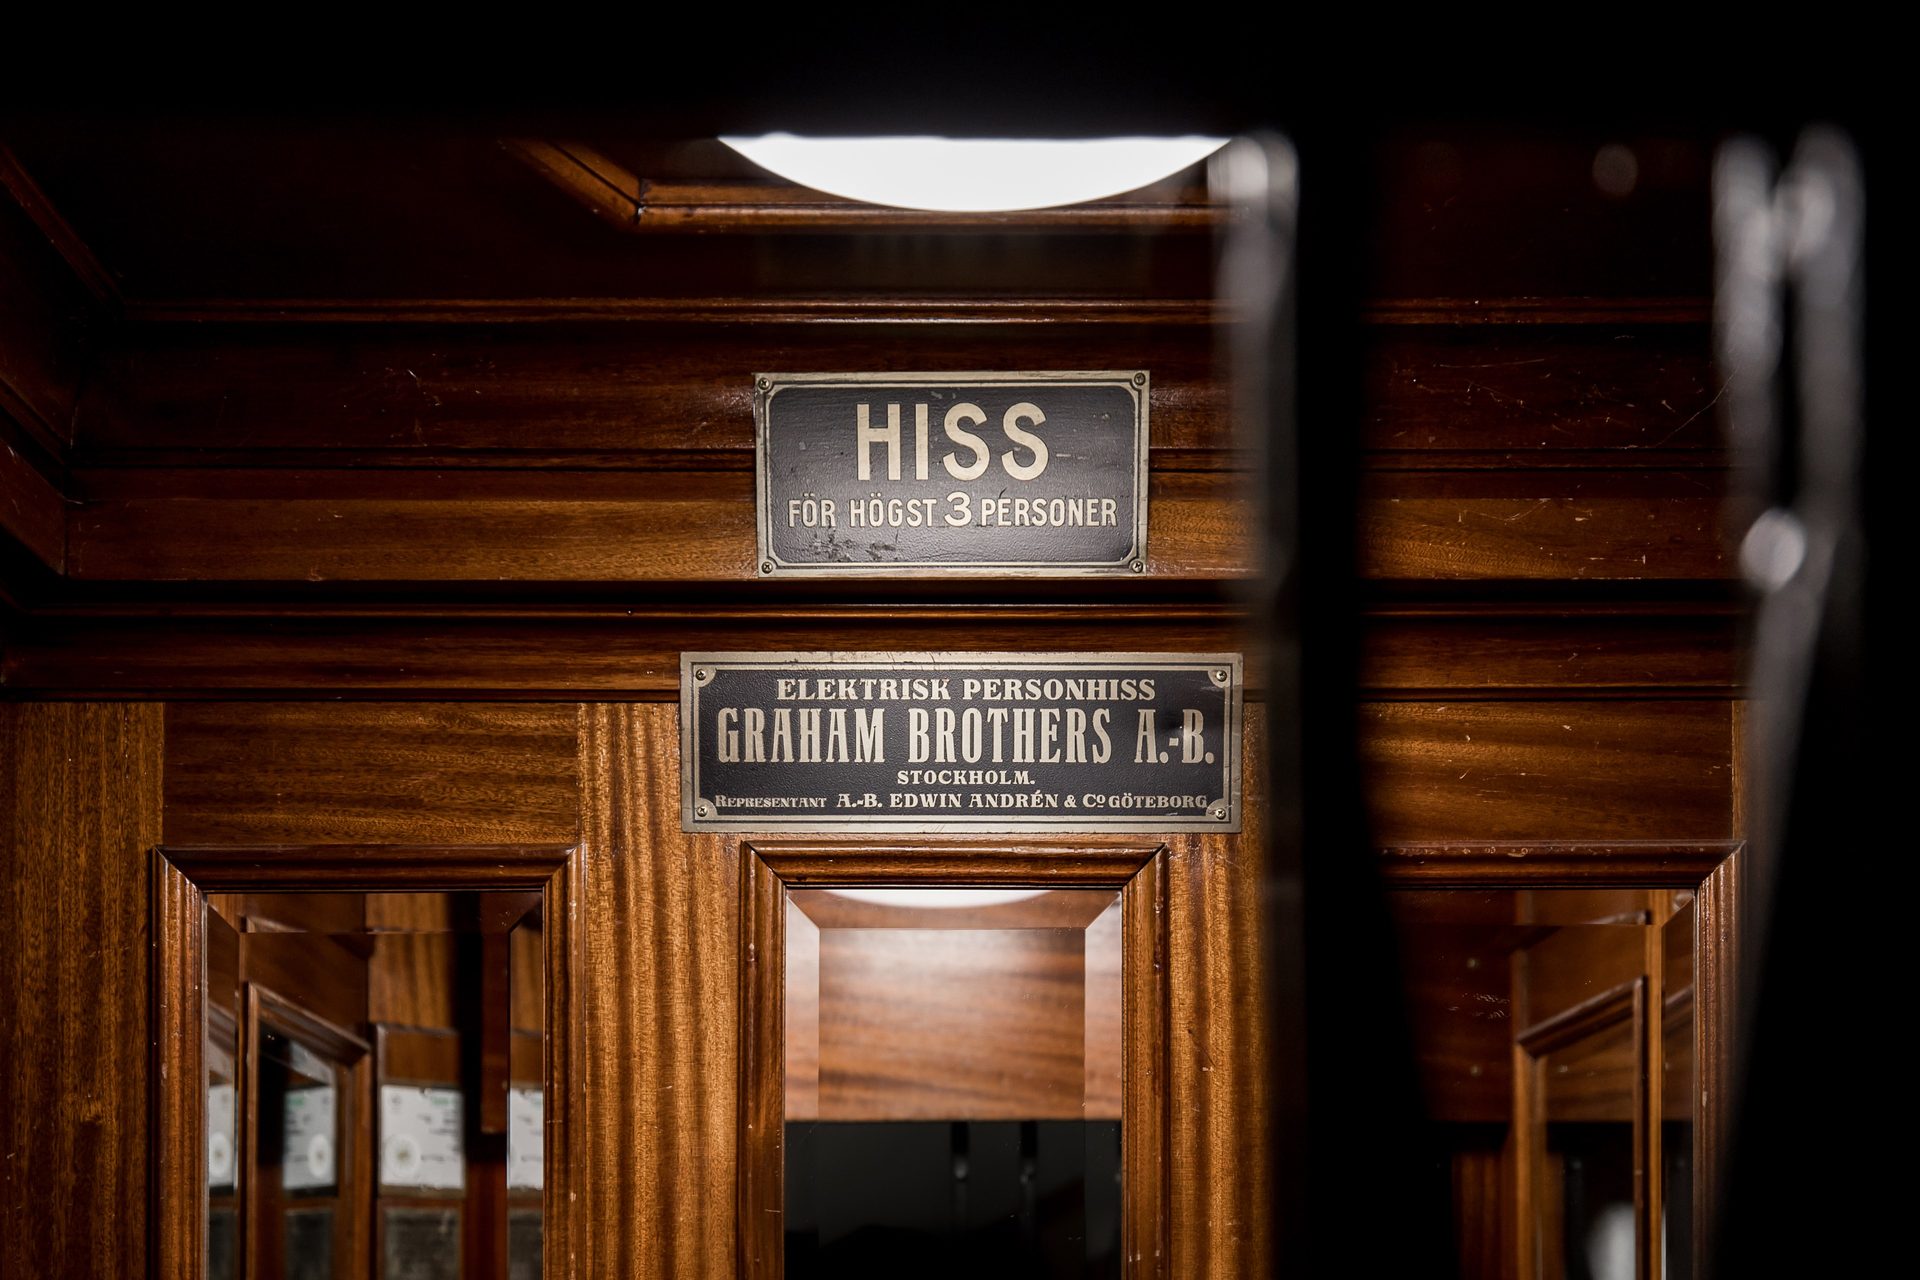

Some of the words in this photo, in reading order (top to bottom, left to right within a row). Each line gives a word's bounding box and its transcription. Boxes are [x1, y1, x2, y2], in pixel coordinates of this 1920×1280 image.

[856, 402, 1050, 481] HISS
[788, 492, 837, 528] FÖR
[849, 492, 937, 528] HÖGST
[943, 491, 973, 528] 3
[980, 497, 1118, 528] PERSONER
[776, 678, 951, 701] ELEKTRISK
[963, 678, 1156, 701] PERSONHISS
[717, 707, 885, 763] GRAHAM
[908, 707, 1112, 764] BROTHERS
[1133, 708, 1215, 765] A.-B.
[897, 769, 1036, 786] STOCKHOLM.
[714, 794, 828, 808] REPRESENTANT
[836, 793, 883, 808] A.-B.
[889, 793, 963, 808] EDWIN
[969, 789, 1059, 808] ANDRÉN
[1063, 794, 1077, 808] &
[1108, 793, 1208, 808] GÖTEBORG
